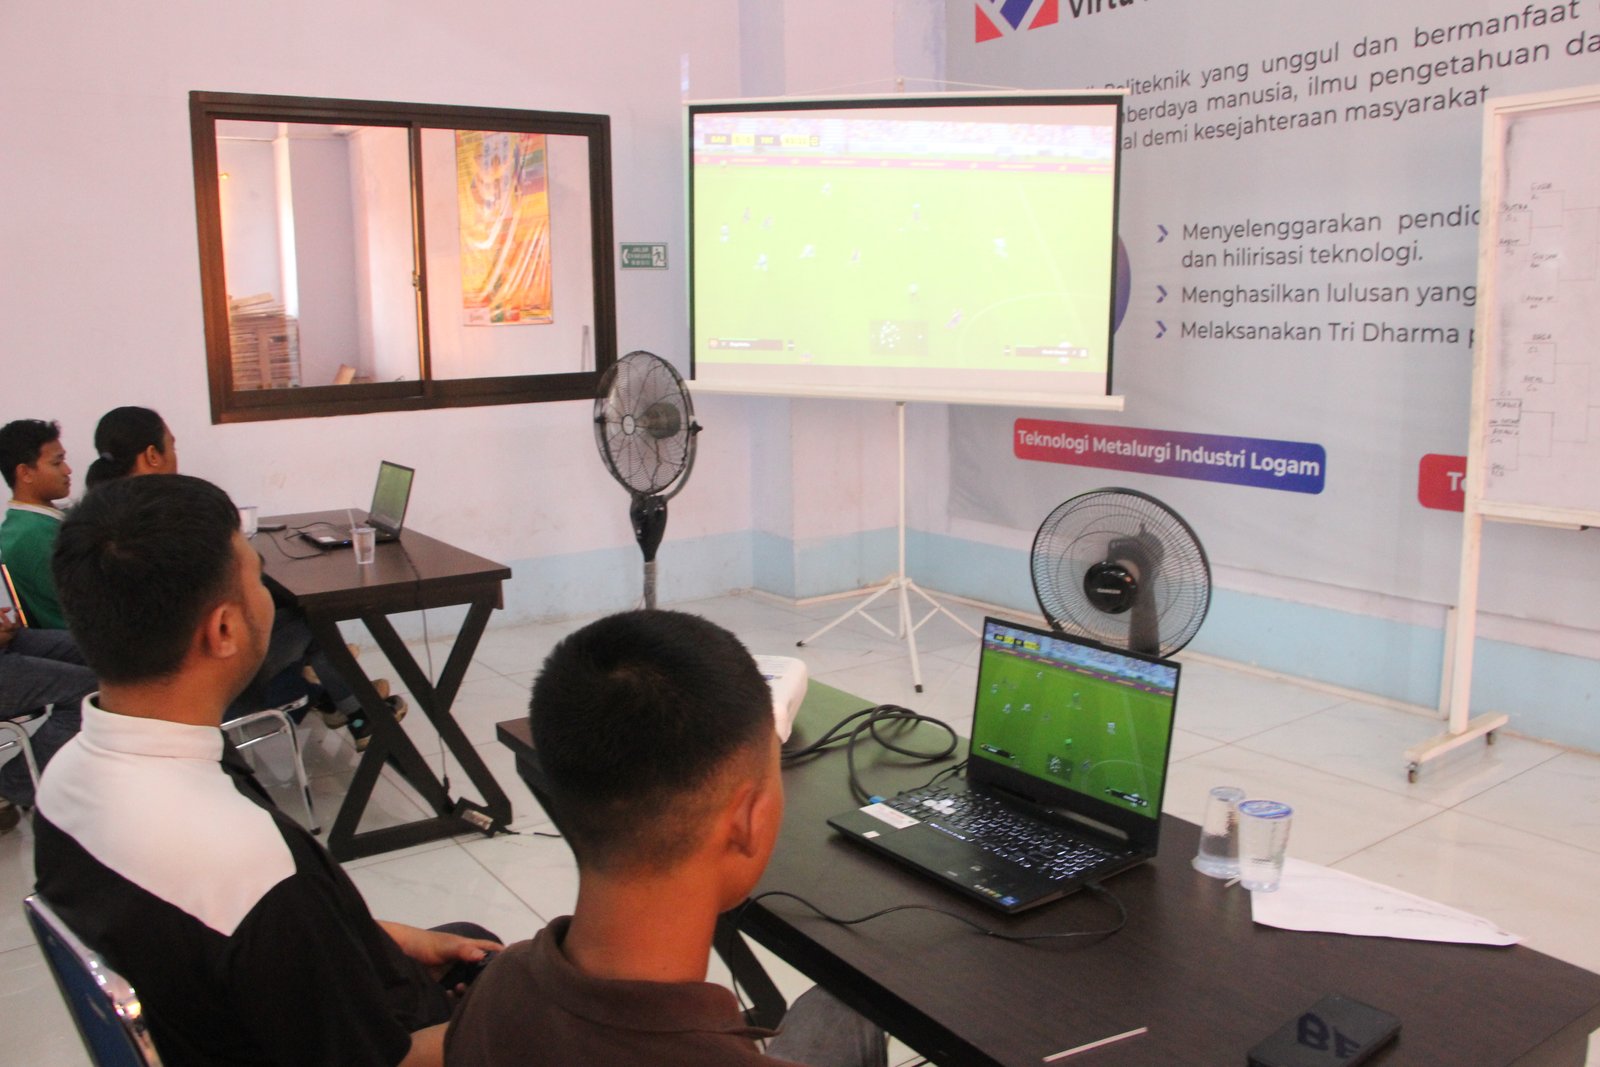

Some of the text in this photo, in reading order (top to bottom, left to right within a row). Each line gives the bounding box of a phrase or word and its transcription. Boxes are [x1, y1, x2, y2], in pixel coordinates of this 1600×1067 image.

[1105, 0, 1580, 96] iteknik yang unggul dan bermanfaat
[1206, 81, 1298, 112] manusia,
[1308, 75, 1358, 96] ilmu
[1370, 43, 1550, 93] pengetahuan
[1121, 85, 1490, 150] al demi kesejahteraan masyarakat
[1183, 213, 1382, 244] Menyelenggarakan
[1181, 240, 1423, 268] dan hilirisasi teknologi.
[1181, 282, 1477, 308] Menghasilkan lulusan yang
[1180, 320, 1321, 341] Melaksanakan
[1328, 321, 1355, 341] Tri
[1363, 321, 1460, 343] Dharma
[1017, 430, 1320, 477] Teknologi Metalurgi Industri Logam
